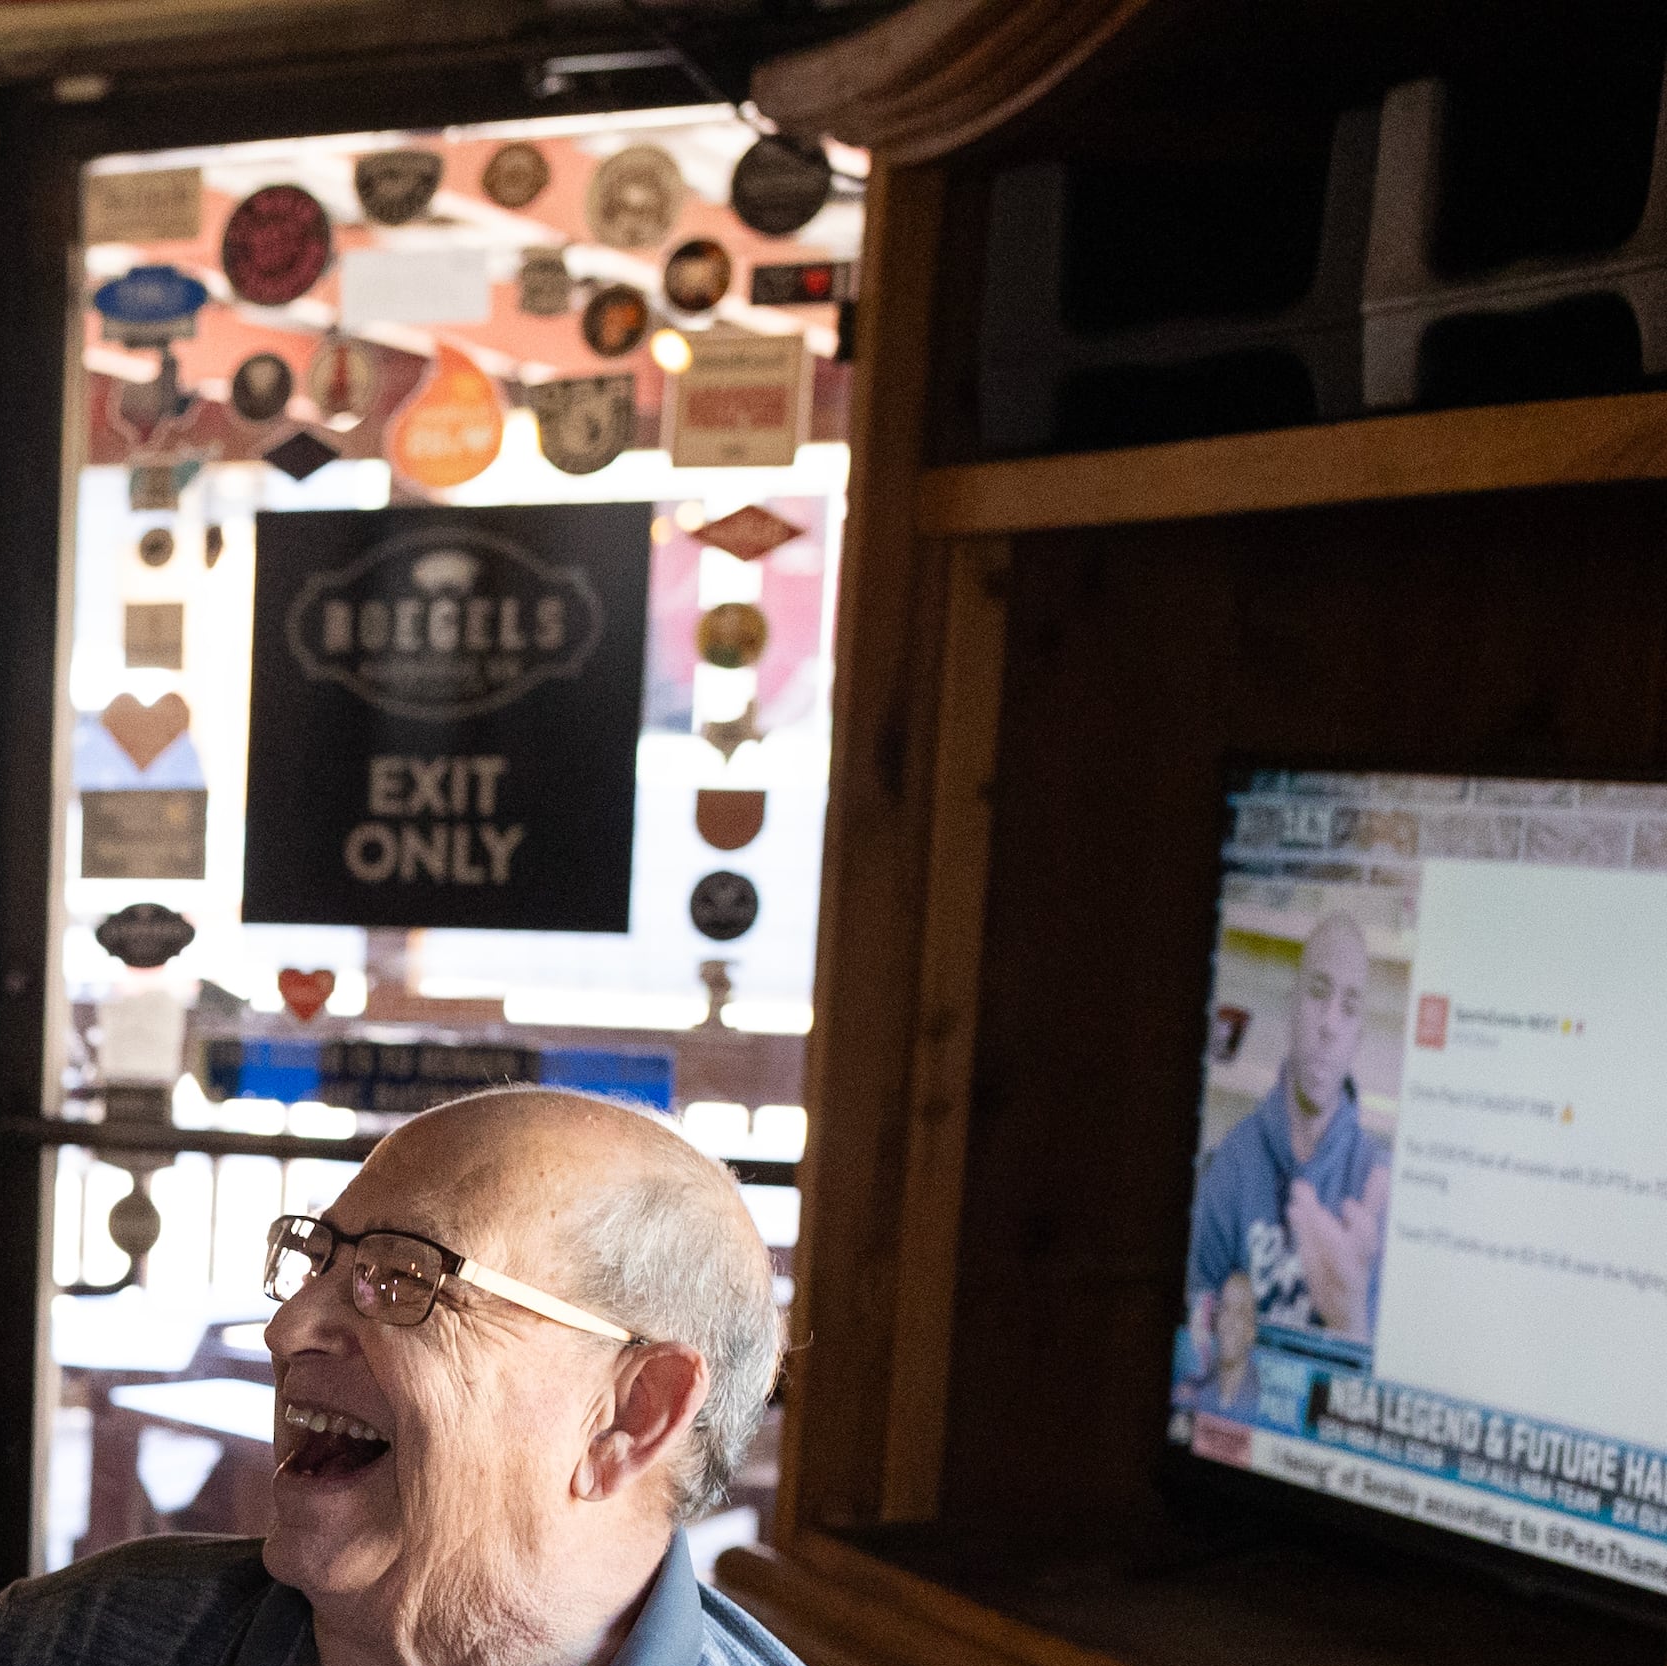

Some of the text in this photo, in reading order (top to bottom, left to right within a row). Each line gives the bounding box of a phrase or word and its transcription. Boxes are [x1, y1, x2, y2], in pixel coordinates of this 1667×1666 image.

[370, 754, 510, 816] EXIT
[344, 823, 527, 886] ONLY
[1327, 1378, 1378, 1422] NBA
[1383, 1389, 1482, 1451] LEGEND
[1485, 1415, 1506, 1460] &
[1511, 1422, 1617, 1490] FUTURE
